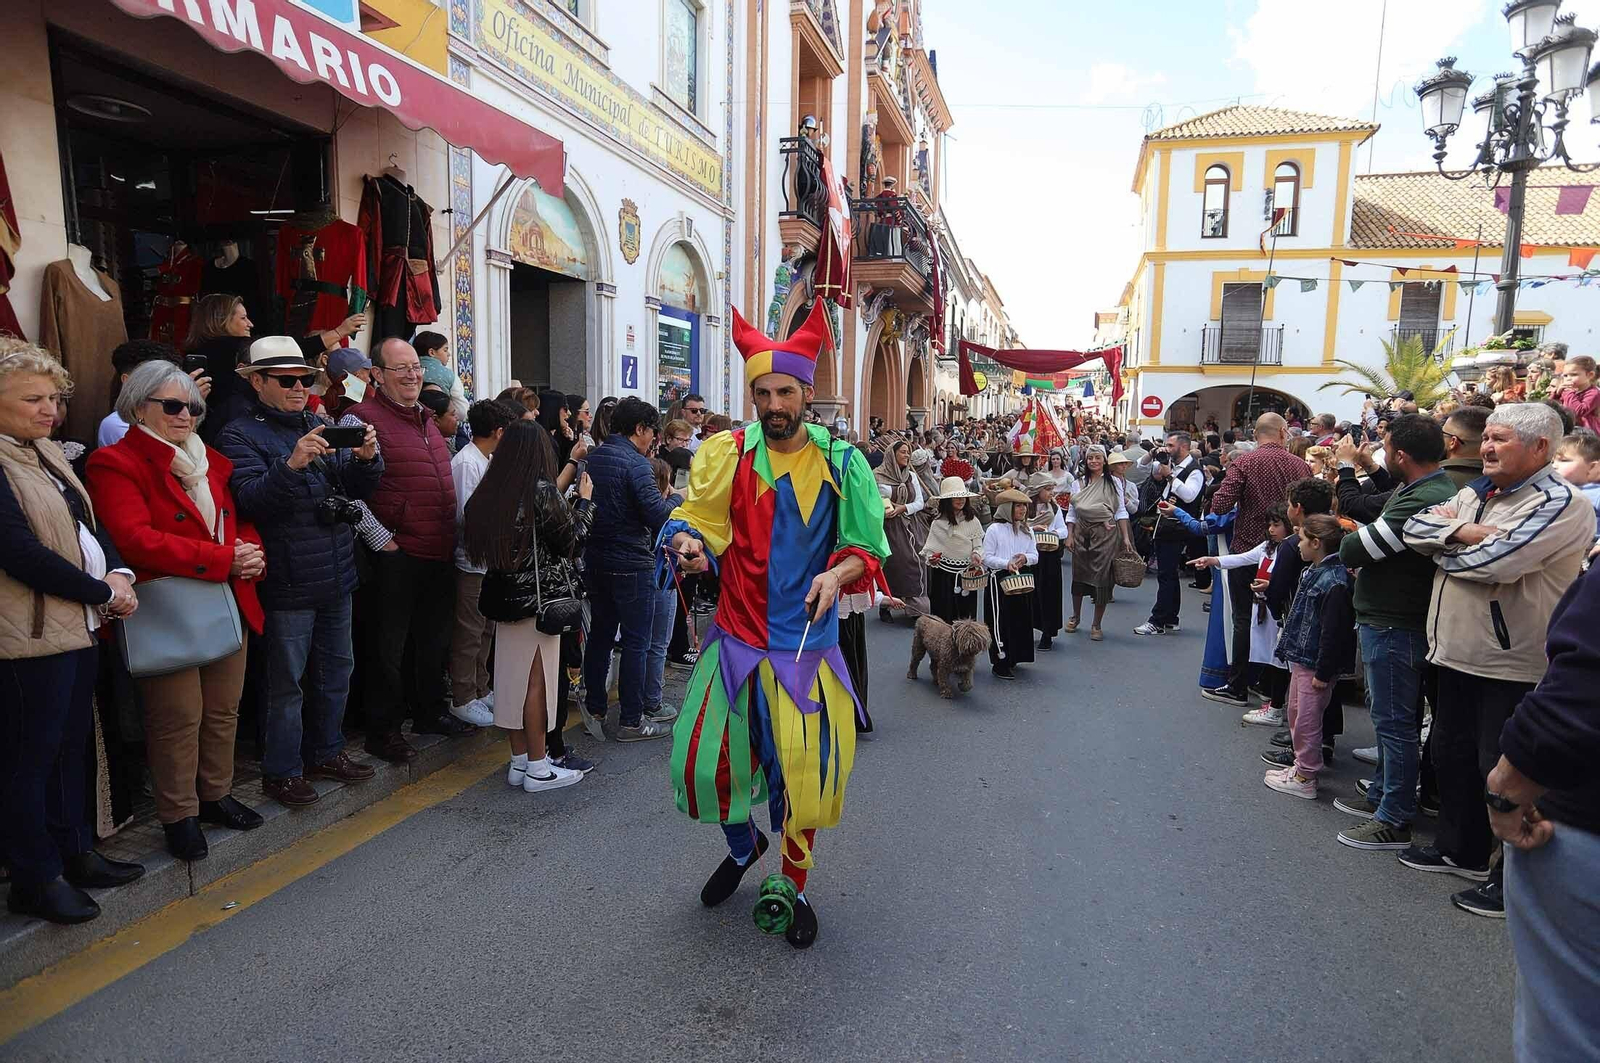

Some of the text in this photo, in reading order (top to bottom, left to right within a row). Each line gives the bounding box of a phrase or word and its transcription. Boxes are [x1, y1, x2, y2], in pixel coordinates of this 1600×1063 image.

[493, 10, 716, 184] Oficina Municipal de TURISMO
